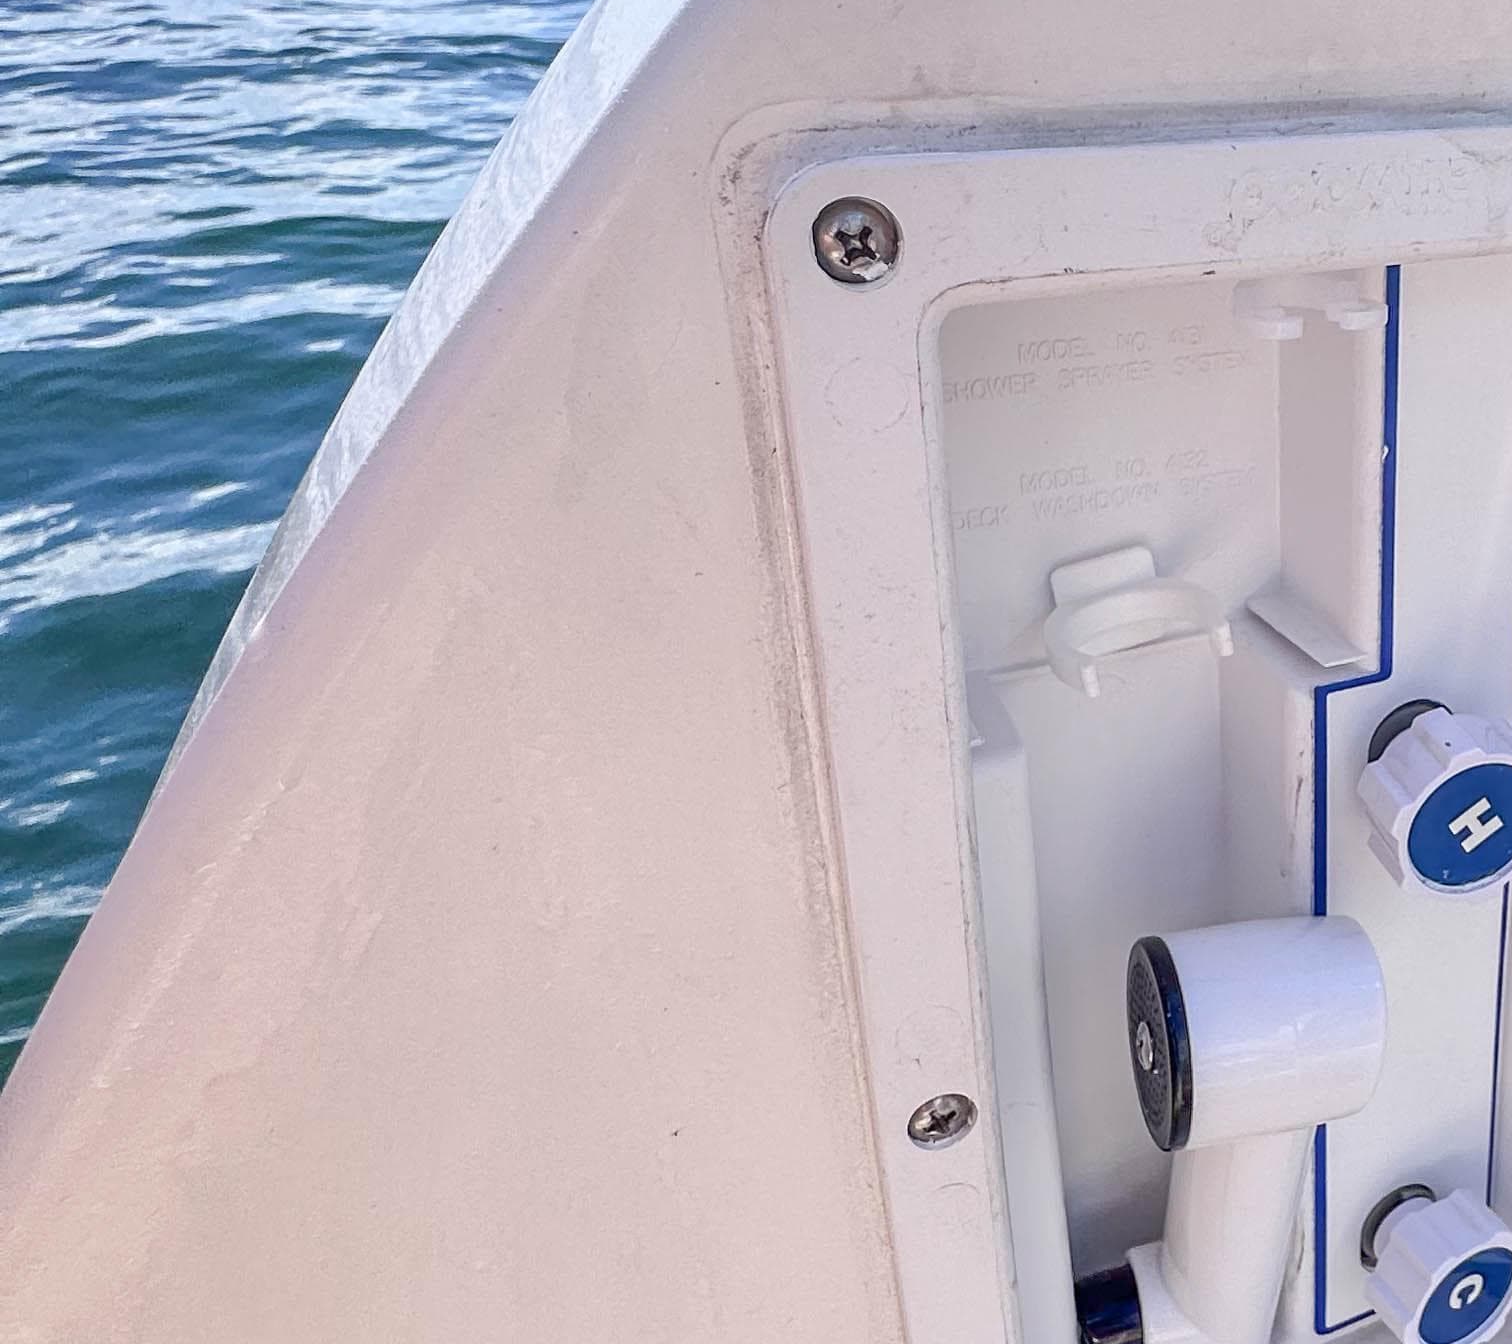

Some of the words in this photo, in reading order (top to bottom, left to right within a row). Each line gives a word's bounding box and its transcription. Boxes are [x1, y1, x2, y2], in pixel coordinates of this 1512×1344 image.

[1018, 338, 1095, 364] MODEL
[1019, 465, 1094, 497] MODEL
[1448, 797, 1504, 853] H
[1450, 1272, 1484, 1310] C
